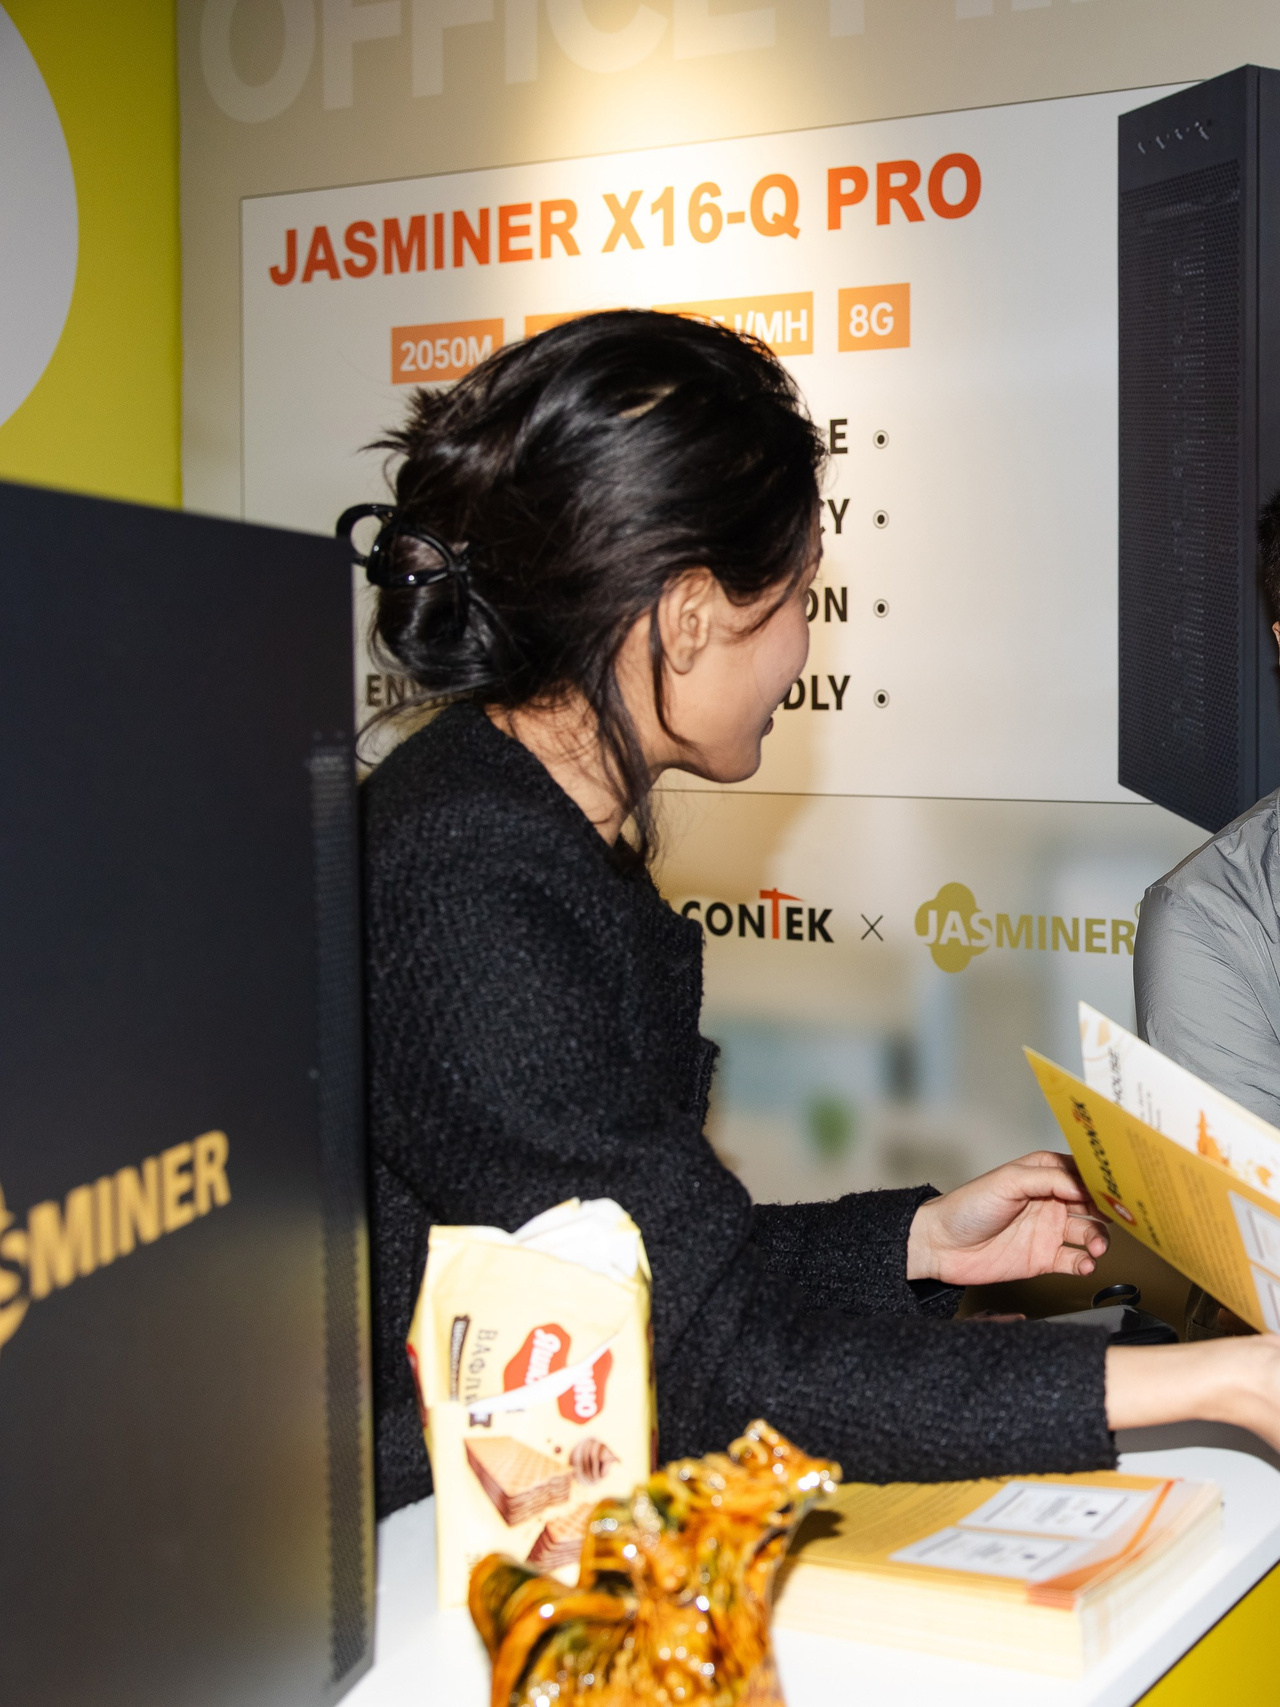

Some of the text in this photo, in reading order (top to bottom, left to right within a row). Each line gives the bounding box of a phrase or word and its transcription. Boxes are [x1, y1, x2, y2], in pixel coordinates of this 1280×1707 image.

[269, 152, 982, 287] JASMINER X16-Q PRO
[849, 302, 895, 338] 8G
[916, 907, 1136, 957] JASMINER
